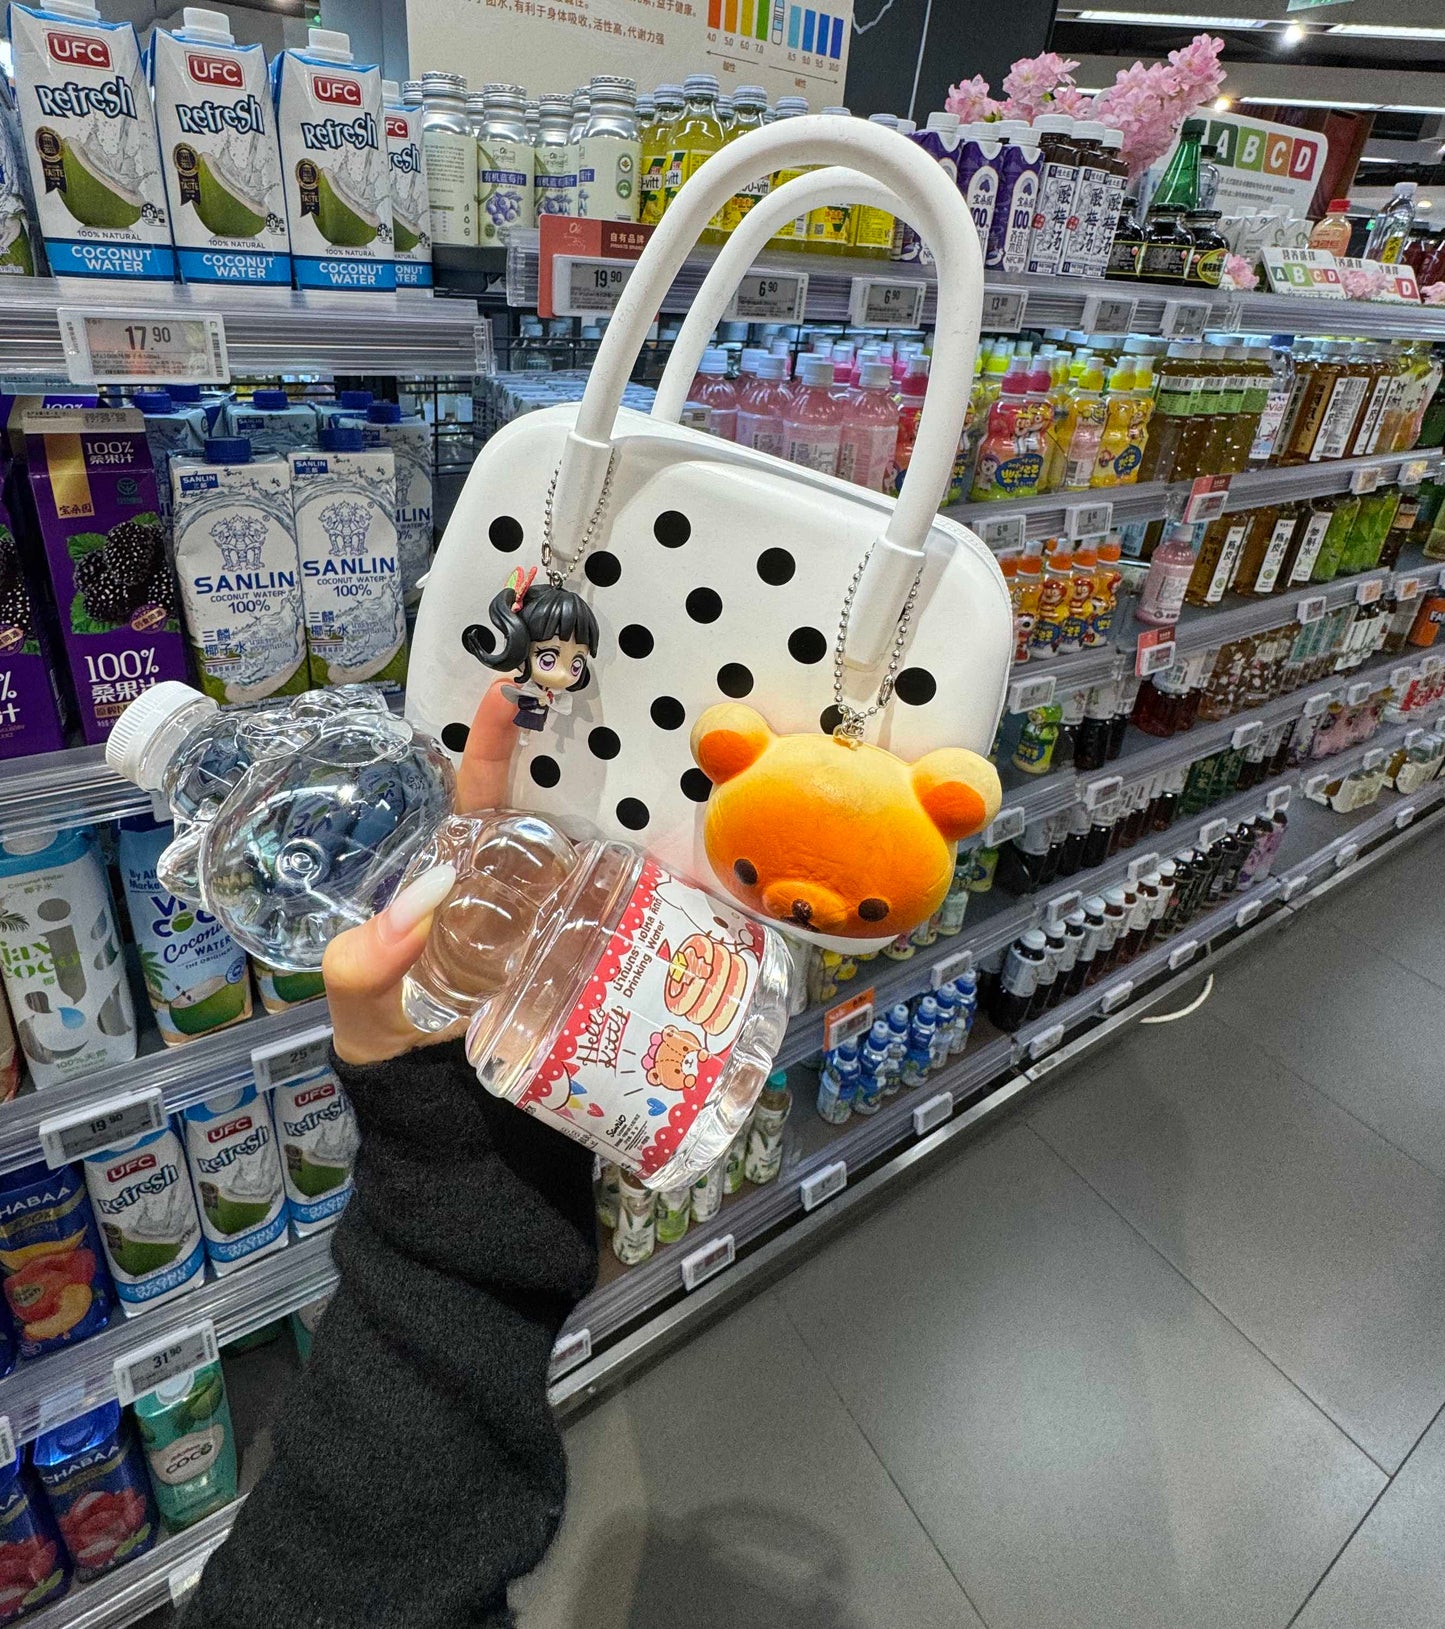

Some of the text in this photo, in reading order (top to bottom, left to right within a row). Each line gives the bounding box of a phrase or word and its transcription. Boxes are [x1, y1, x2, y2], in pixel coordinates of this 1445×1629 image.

[52, 36, 106, 64] UFC
[194, 58, 240, 84] UFC
[316, 80, 358, 102] UFC
[386, 122, 407, 137] FC
[1216, 131, 1311, 173] A B C D
[76, 230, 142, 242] 100% NATURAL
[610, 232, 644, 244] 自有品牌
[208, 240, 266, 250] 100% NATURAL
[71, 246, 152, 262] COCONUT
[202, 254, 274, 268] COCONUT
[346, 249, 376, 258] NATURAL
[85, 259, 144, 273] WATER
[214, 266, 266, 280] WATER
[319, 262, 383, 276] COCONUT
[330, 272, 376, 286] WATER
[1276, 264, 1336, 284] A B C D
[1402, 281, 1412, 296] D
[85, 441, 134, 455] 100%
[295, 460, 326, 469] SANLIN
[182, 475, 216, 484] SANLIN
[59, 503, 93, 516] 宝桑园
[302, 556, 396, 577] SANLIN
[194, 570, 296, 595] SANLIN
[316, 575, 386, 586] COCONUT WATER
[210, 590, 283, 603] COCONUT WATER
[332, 584, 373, 598] 100%
[228, 600, 272, 614] 100%
[310, 623, 350, 637] 椰子水
[205, 641, 247, 656] 椰子水
[84, 647, 160, 683] 100%
[130, 878, 162, 890] Marke
[622, 919, 666, 999] Drinking Water
[576, 1004, 606, 1067] Hello
[598, 1004, 626, 1077] Kitty
[298, 1085, 334, 1106] UFC
[210, 1118, 250, 1141] UFC
[110, 1156, 154, 1180] UFC
[0, 1186, 72, 1219] HABAA
[126, 1261, 193, 1296] COCONUT
[136, 1274, 187, 1300] WATER
[42, 1445, 120, 1485] CHABAA
